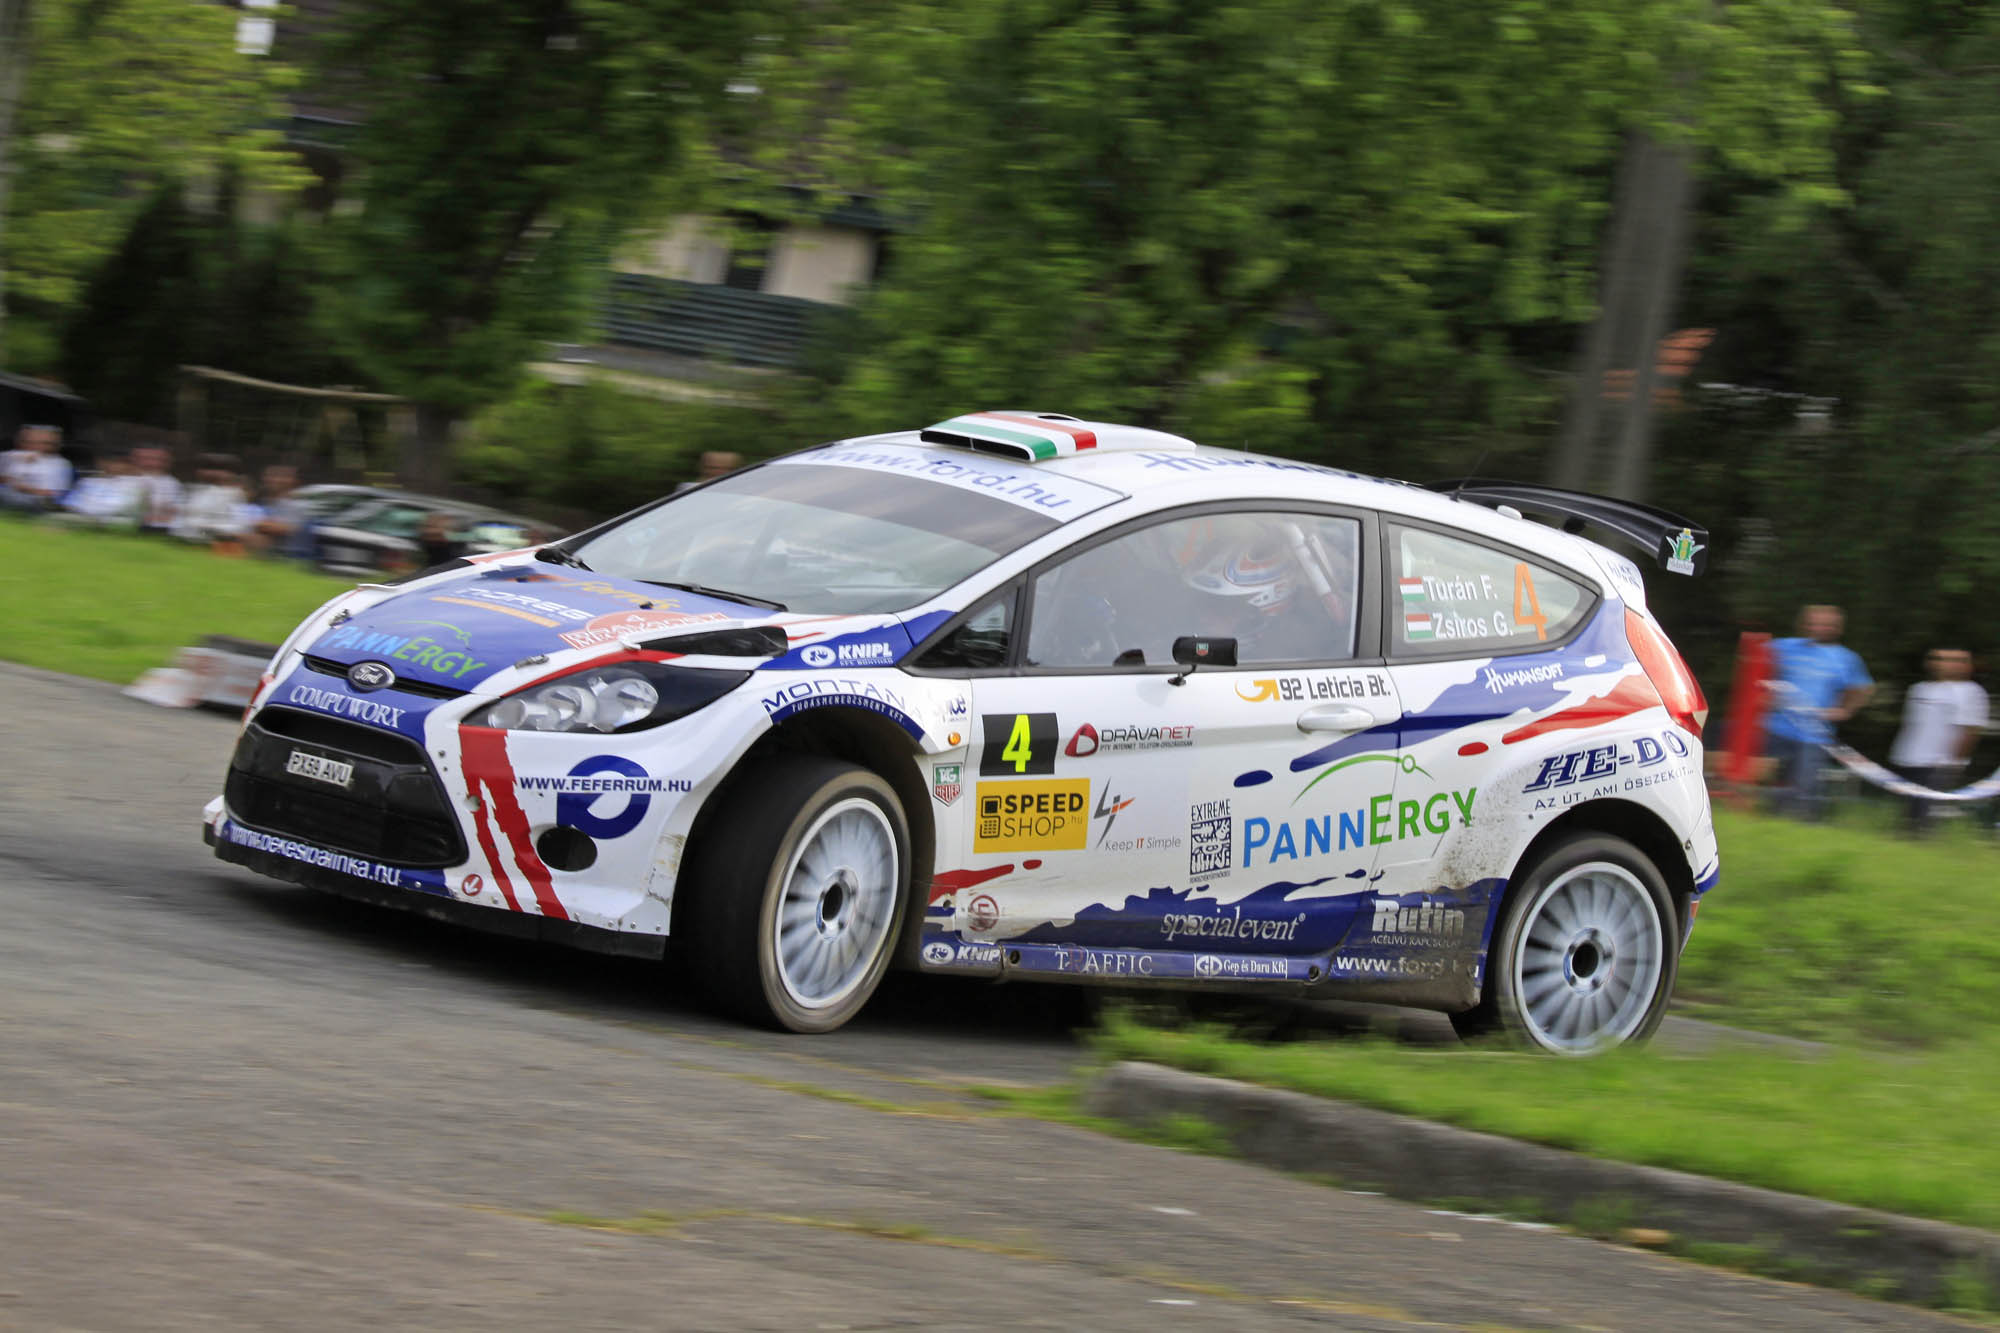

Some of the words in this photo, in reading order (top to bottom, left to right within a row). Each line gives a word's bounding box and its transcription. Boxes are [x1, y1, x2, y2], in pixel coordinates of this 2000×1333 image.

[809, 449, 1071, 509] www.ford.hu
[1423, 576, 1477, 601] Turán
[1480, 575, 1498, 600] F.
[1514, 563, 1548, 640] 4
[1493, 610, 1514, 637] G.
[838, 642, 892, 659] KNIPL
[353, 665, 385, 685] Ford
[1280, 678, 1304, 700] 92
[1307, 675, 1364, 699] Leticia
[1367, 674, 1391, 697] Bt.
[290, 685, 406, 729] COMPUWORX
[1002, 714, 1032, 772] 4
[320, 763, 350, 783] AVU
[1522, 731, 1688, 793] HE-DO
[520, 776, 692, 793] WWW.FEFERRUM.HU
[939, 768, 957, 783] TAG
[936, 784, 960, 803] HEUER
[1004, 793, 1083, 814] SPEED
[1535, 799, 1556, 811] AZ
[1593, 784, 1618, 798] AMI
[1191, 799, 1231, 822] EXTREME
[1003, 816, 1065, 838] SHOP
[1105, 840, 1134, 852] Keep
[1136, 838, 1145, 849] IT
[1147, 836, 1181, 850] Simple
[1372, 899, 1465, 936] Rutin
